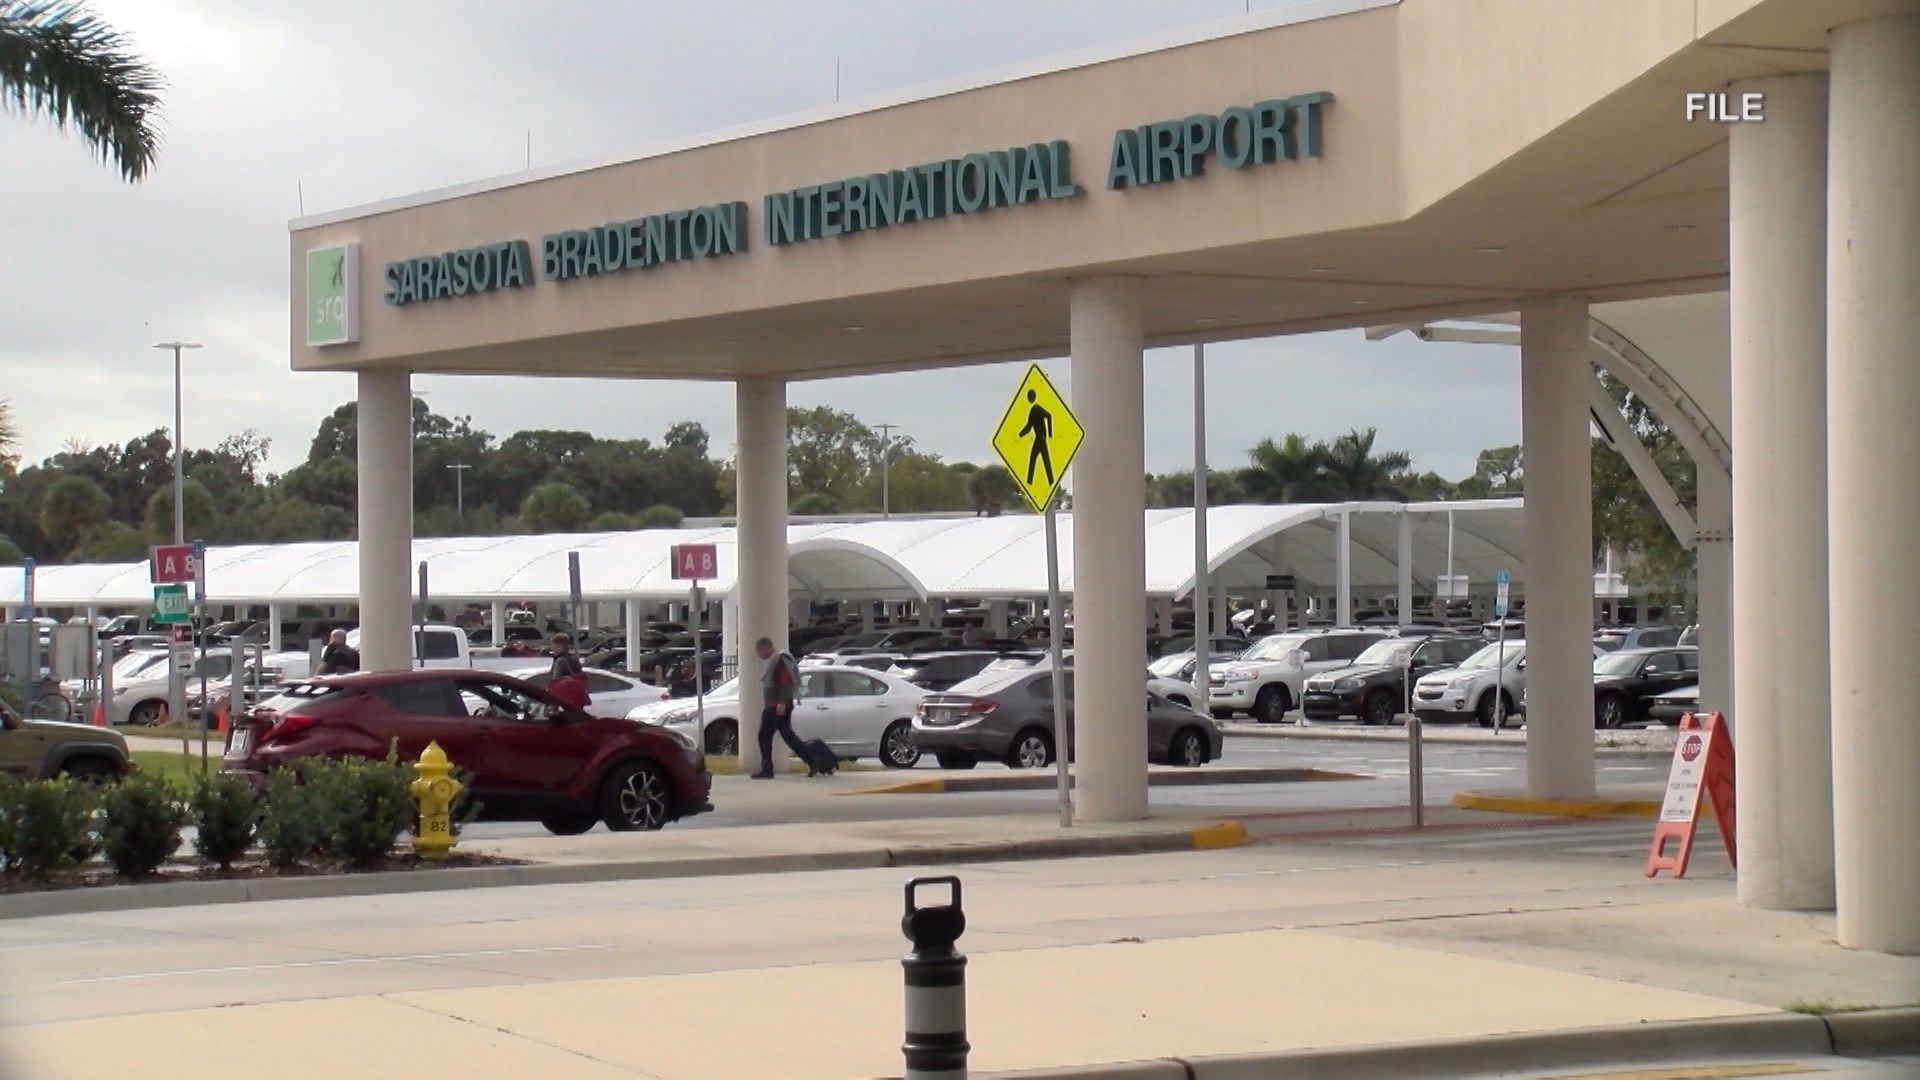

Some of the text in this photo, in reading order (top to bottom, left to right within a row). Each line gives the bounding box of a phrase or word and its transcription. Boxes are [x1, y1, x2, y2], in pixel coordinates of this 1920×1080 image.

[385, 92, 1332, 305] SARASOTA BRADENTON INTERNATIONAL AIRPORT
[164, 555, 176, 574] A
[684, 552, 695, 570] A
[1681, 743, 1702, 754] STOP
[431, 821, 447, 832] B2
